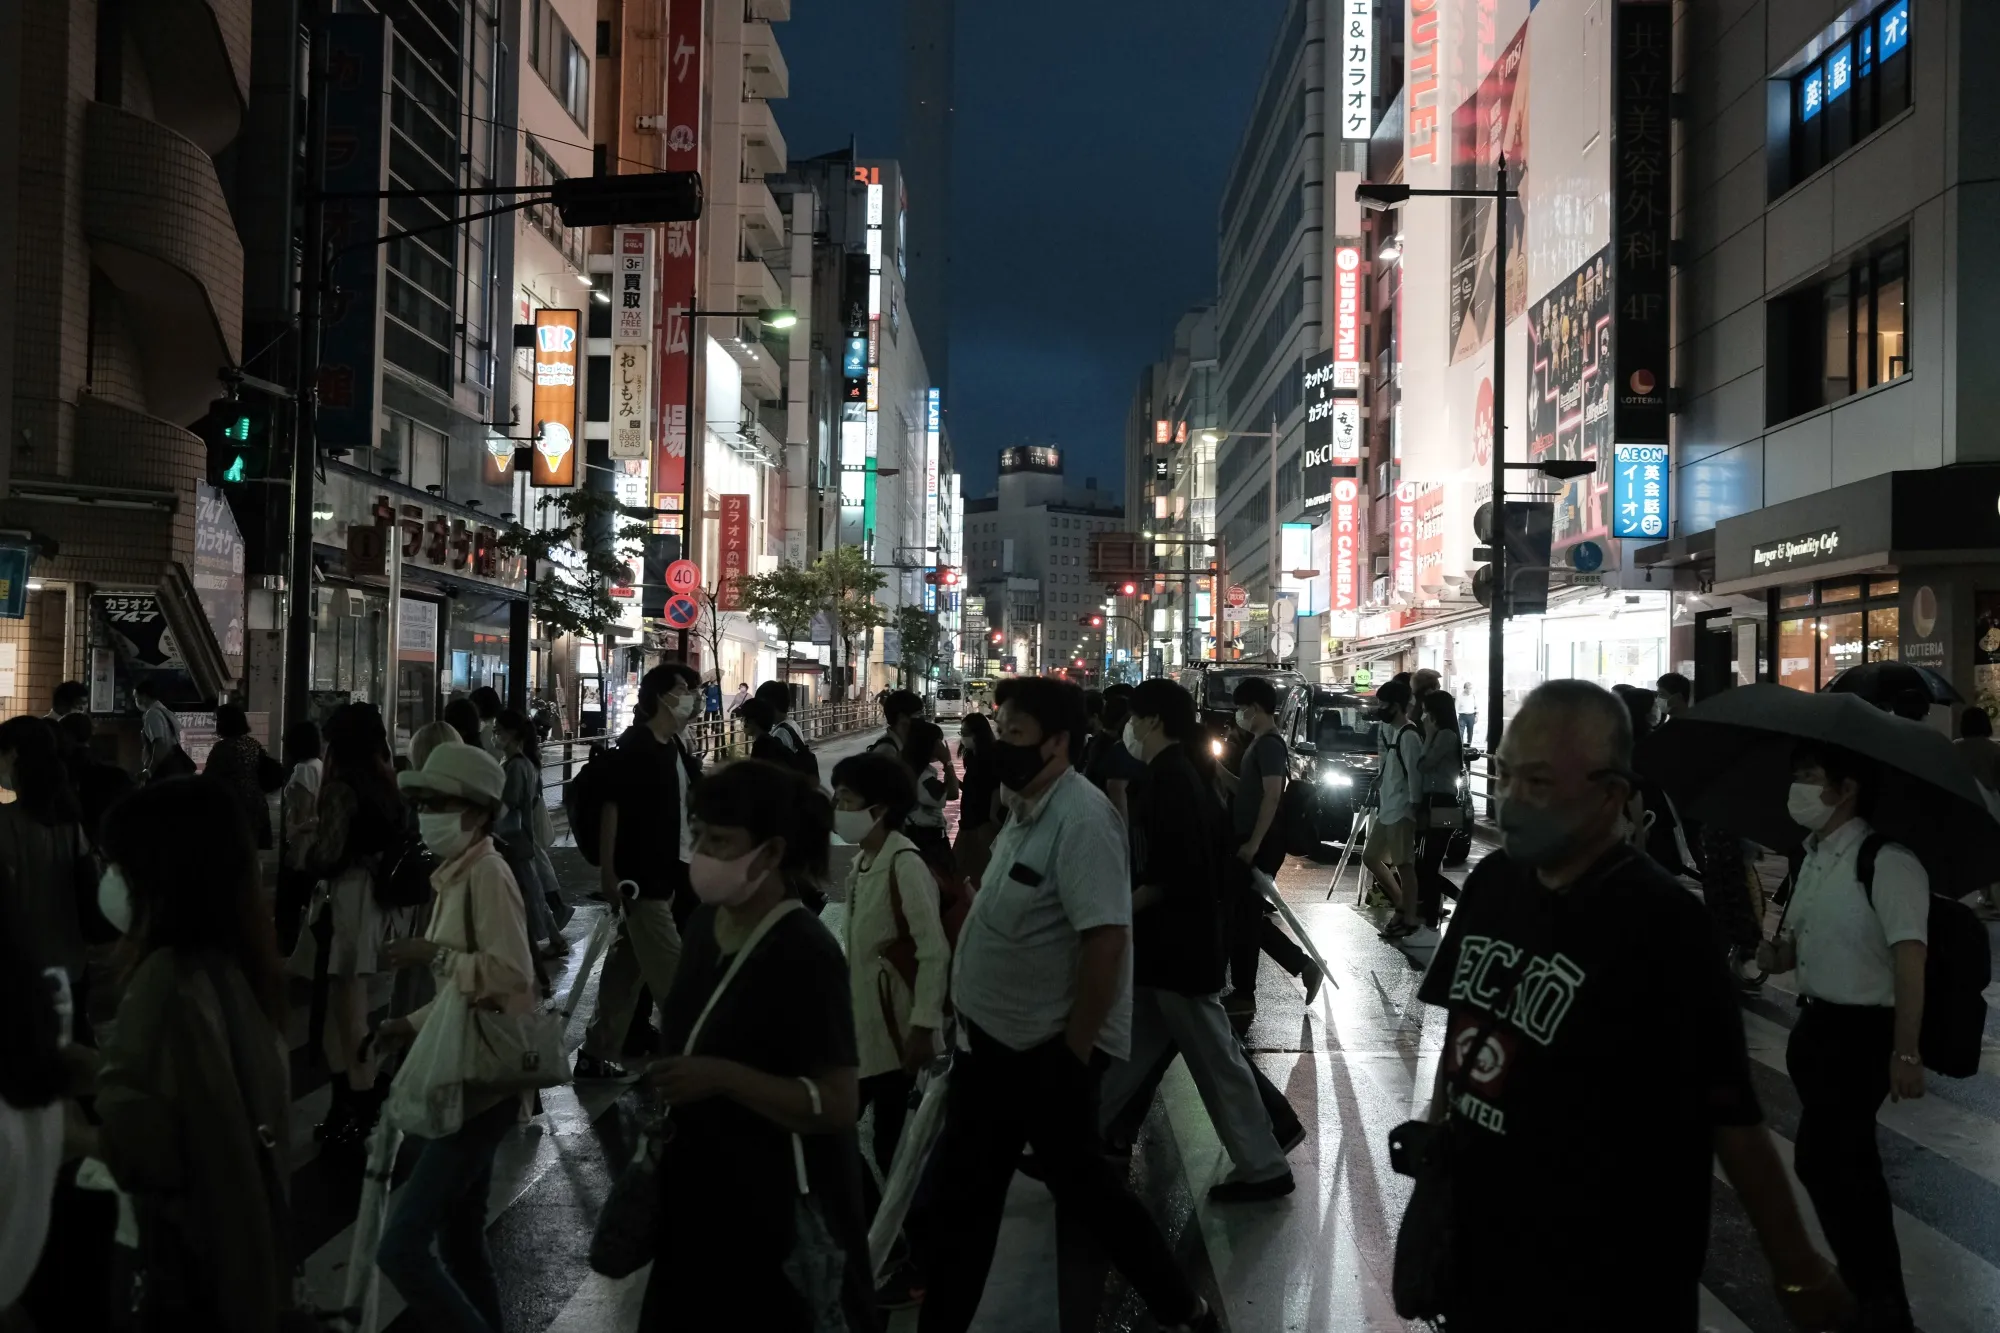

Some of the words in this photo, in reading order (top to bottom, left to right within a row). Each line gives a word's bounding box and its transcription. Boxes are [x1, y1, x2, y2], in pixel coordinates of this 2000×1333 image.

[1621, 22, 1665, 272] 共立美容外科
[626, 259, 641, 270] 3F
[623, 273, 642, 309] 買取
[622, 311, 642, 320] TAX
[1622, 293, 1663, 321] 4F
[621, 319, 642, 328] FREE
[619, 352, 636, 418] おしもみ
[1338, 367, 1356, 385] 酒
[1620, 396, 1664, 406] LOTTERIA
[929, 401, 939, 430] LABI
[1030, 456, 1046, 466] the
[1618, 447, 1664, 462] AEON
[1622, 465, 1639, 534] イーオン
[1643, 465, 1660, 515] 英会話
[199, 496, 224, 525] 747
[1338, 504, 1353, 532] BIC
[1399, 505, 1414, 533] BIC
[1643, 519, 1660, 531] 3F
[197, 525, 233, 556] カラオケ
[1754, 549, 1778, 567] Burger
[1777, 543, 1786, 559] &
[674, 570, 692, 584] 40
[1336, 537, 1353, 607] CAMERA
[105, 598, 155, 611] カラオケ
[107, 610, 160, 623] 747
[1905, 642, 1945, 658] LOTTERIA
